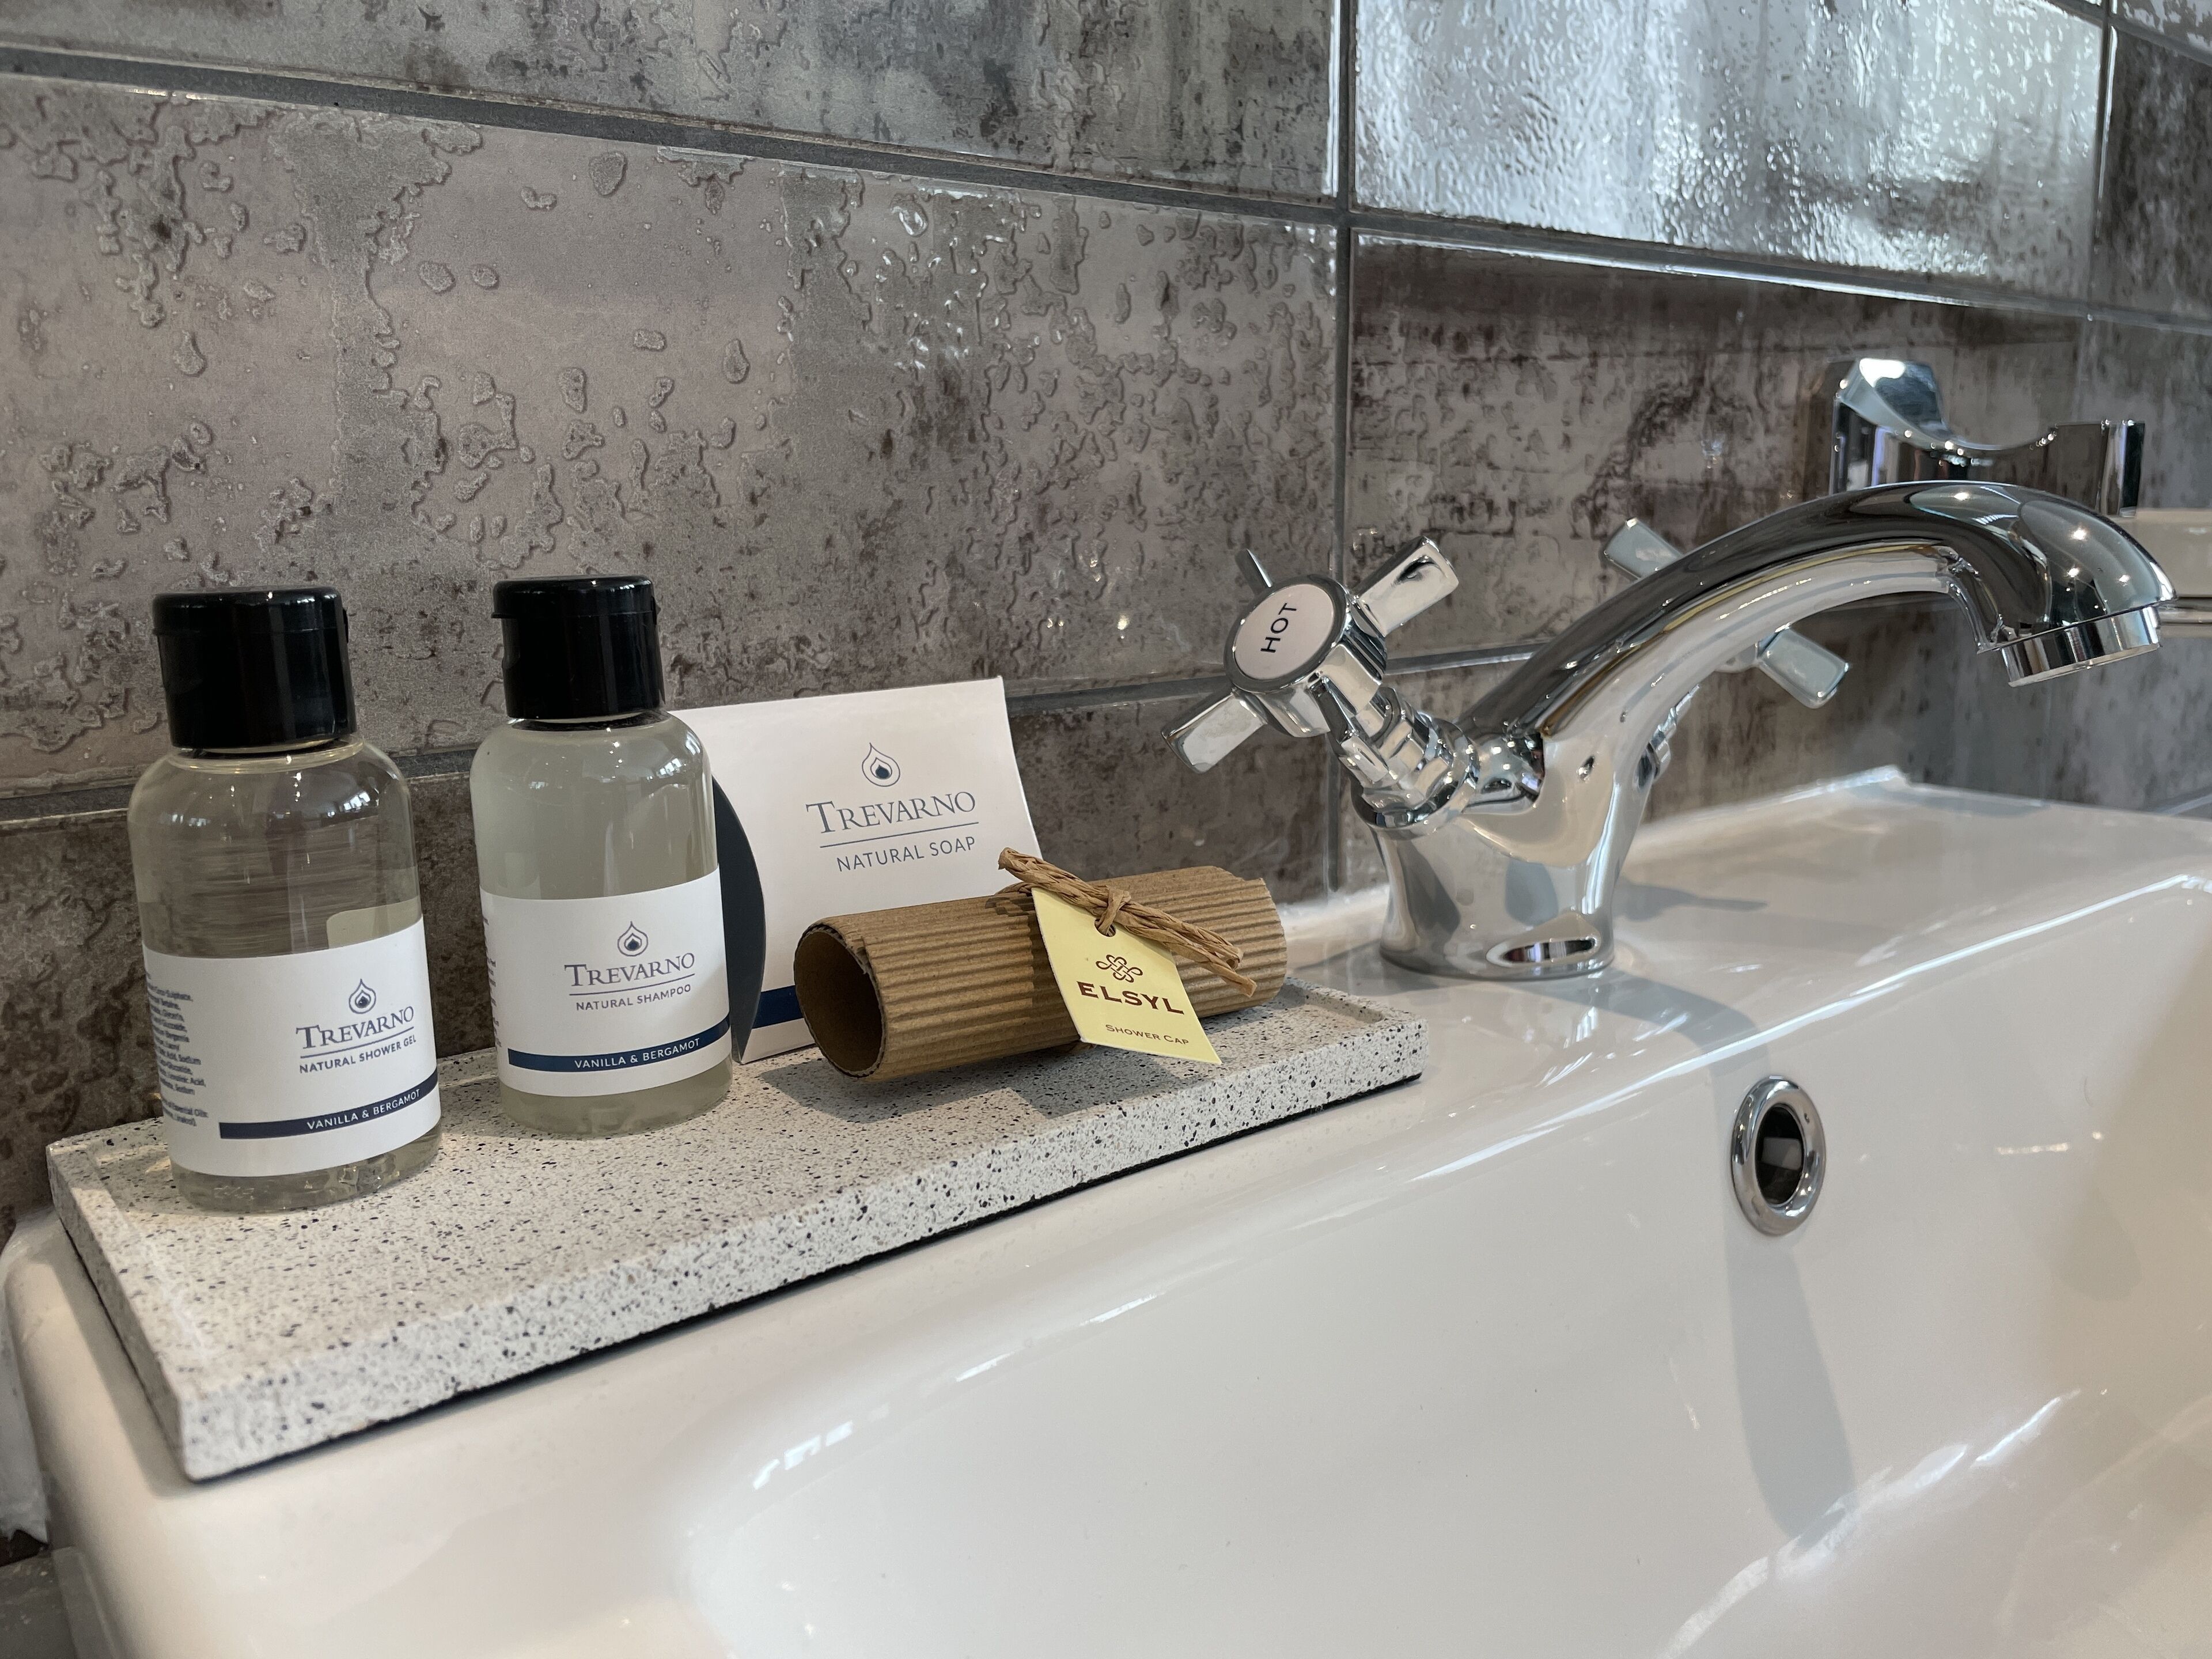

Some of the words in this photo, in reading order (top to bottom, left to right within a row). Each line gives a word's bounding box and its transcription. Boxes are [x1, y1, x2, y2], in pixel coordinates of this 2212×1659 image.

[1260, 603, 1297, 653] HOT
[806, 791, 976, 834] TREVARNO
[836, 844, 925, 872] NATURAL
[929, 836, 976, 857] SOAP
[564, 952, 695, 987] TREVARNO
[575, 997, 634, 1011] NATURAL
[637, 984, 691, 1005] SHAMPOO
[1076, 980, 1184, 1015] ELSYL
[296, 1005, 414, 1050] TREVARNO
[1105, 1024, 1160, 1040] SHOWER
[1163, 1035, 1189, 1046] CAP
[299, 1055, 357, 1074] NATURAL
[359, 1041, 402, 1062] SHOWER
[403, 1035, 416, 1047] GEL
[574, 1056, 627, 1069] VANILLA
[630, 1054, 638, 1063] &
[643, 1037, 700, 1062] BERGAMOT
[306, 1112, 358, 1130] VANILLA
[362, 1109, 370, 1118] &
[373, 1088, 420, 1116] BERGAMOT
